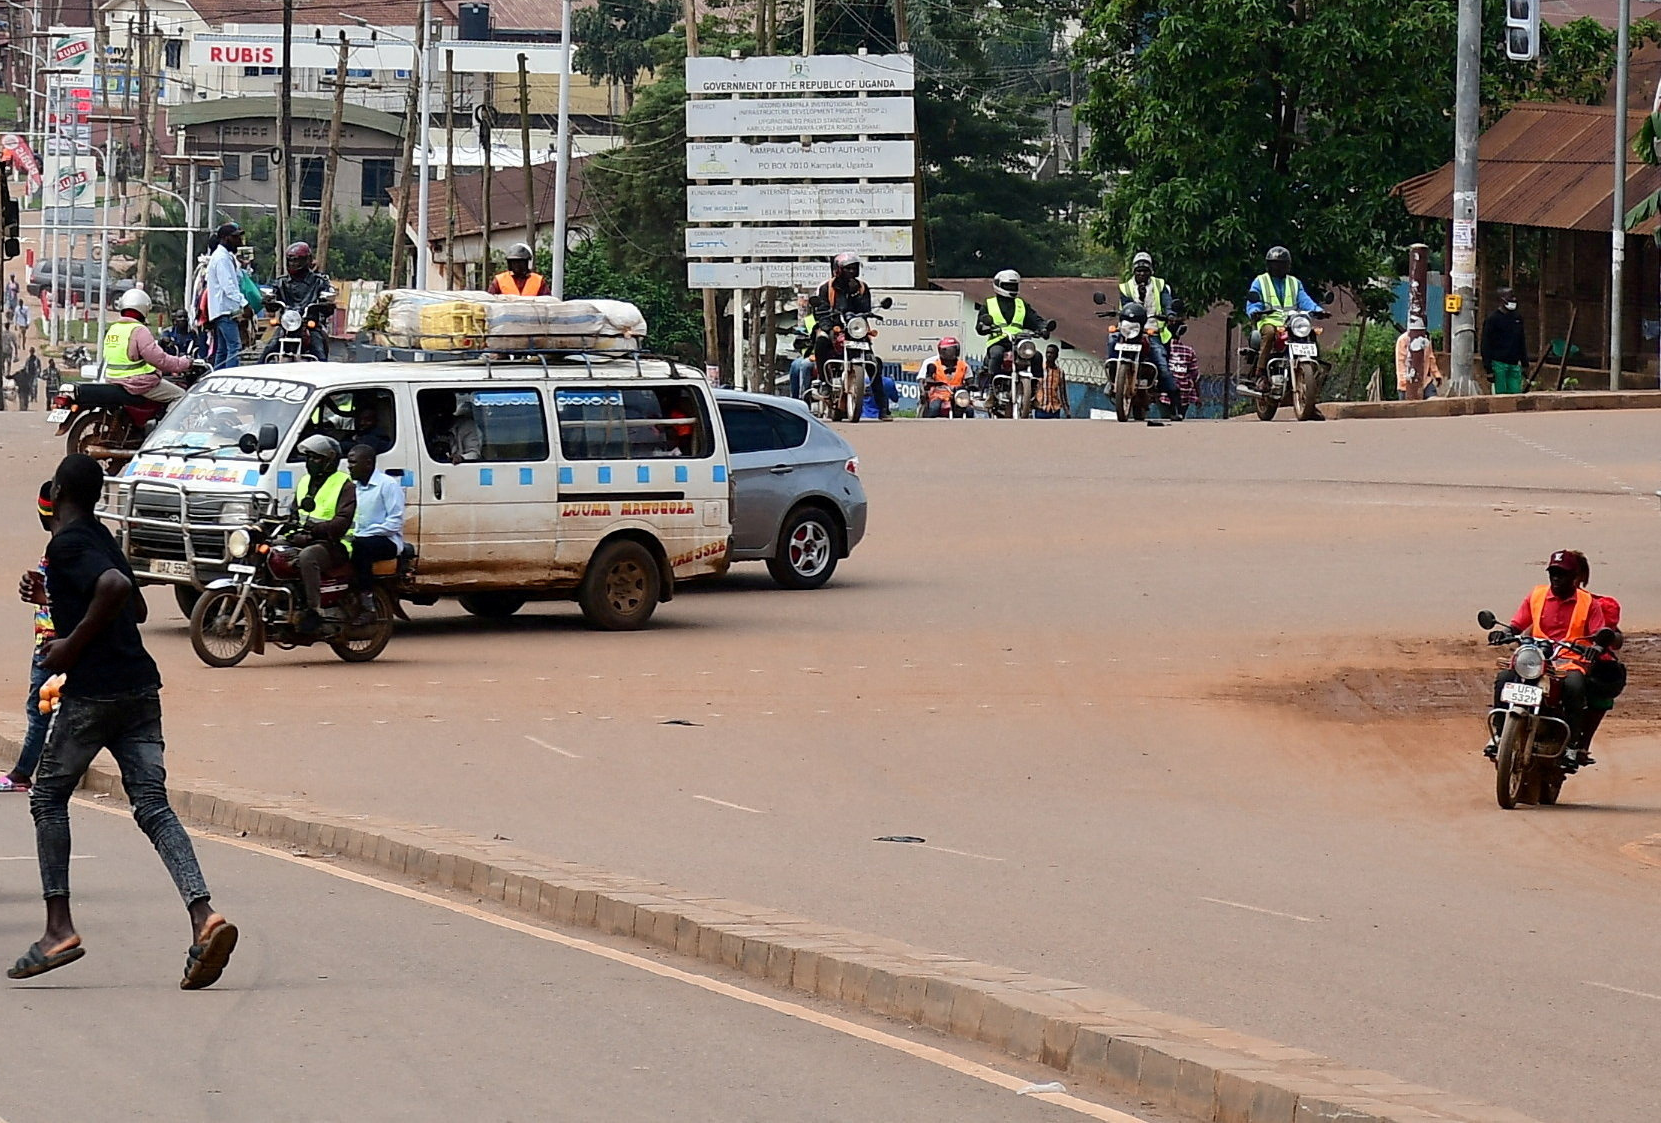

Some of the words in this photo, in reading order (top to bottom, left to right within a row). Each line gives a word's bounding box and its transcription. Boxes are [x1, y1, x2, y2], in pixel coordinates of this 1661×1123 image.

[57, 43, 85, 59] RUBIS
[703, 81, 764, 91] GOVERNMENT
[766, 81, 776, 90] OF
[778, 80, 797, 90] THE
[799, 80, 844, 90] REPUBLIC
[845, 80, 857, 89] OF
[859, 79, 896, 89] UGANDA
[750, 146, 785, 154] KAMPALA
[819, 146, 836, 154] CITY
[838, 146, 882, 154] AUTHORITY
[771, 162, 787, 170] BOX
[875, 319, 908, 327] GLOBAL
[910, 319, 934, 327] FLEET
[937, 319, 959, 327] BASE
[891, 344, 934, 352] KAMPALA
[1517, 685, 1538, 696] UFK
